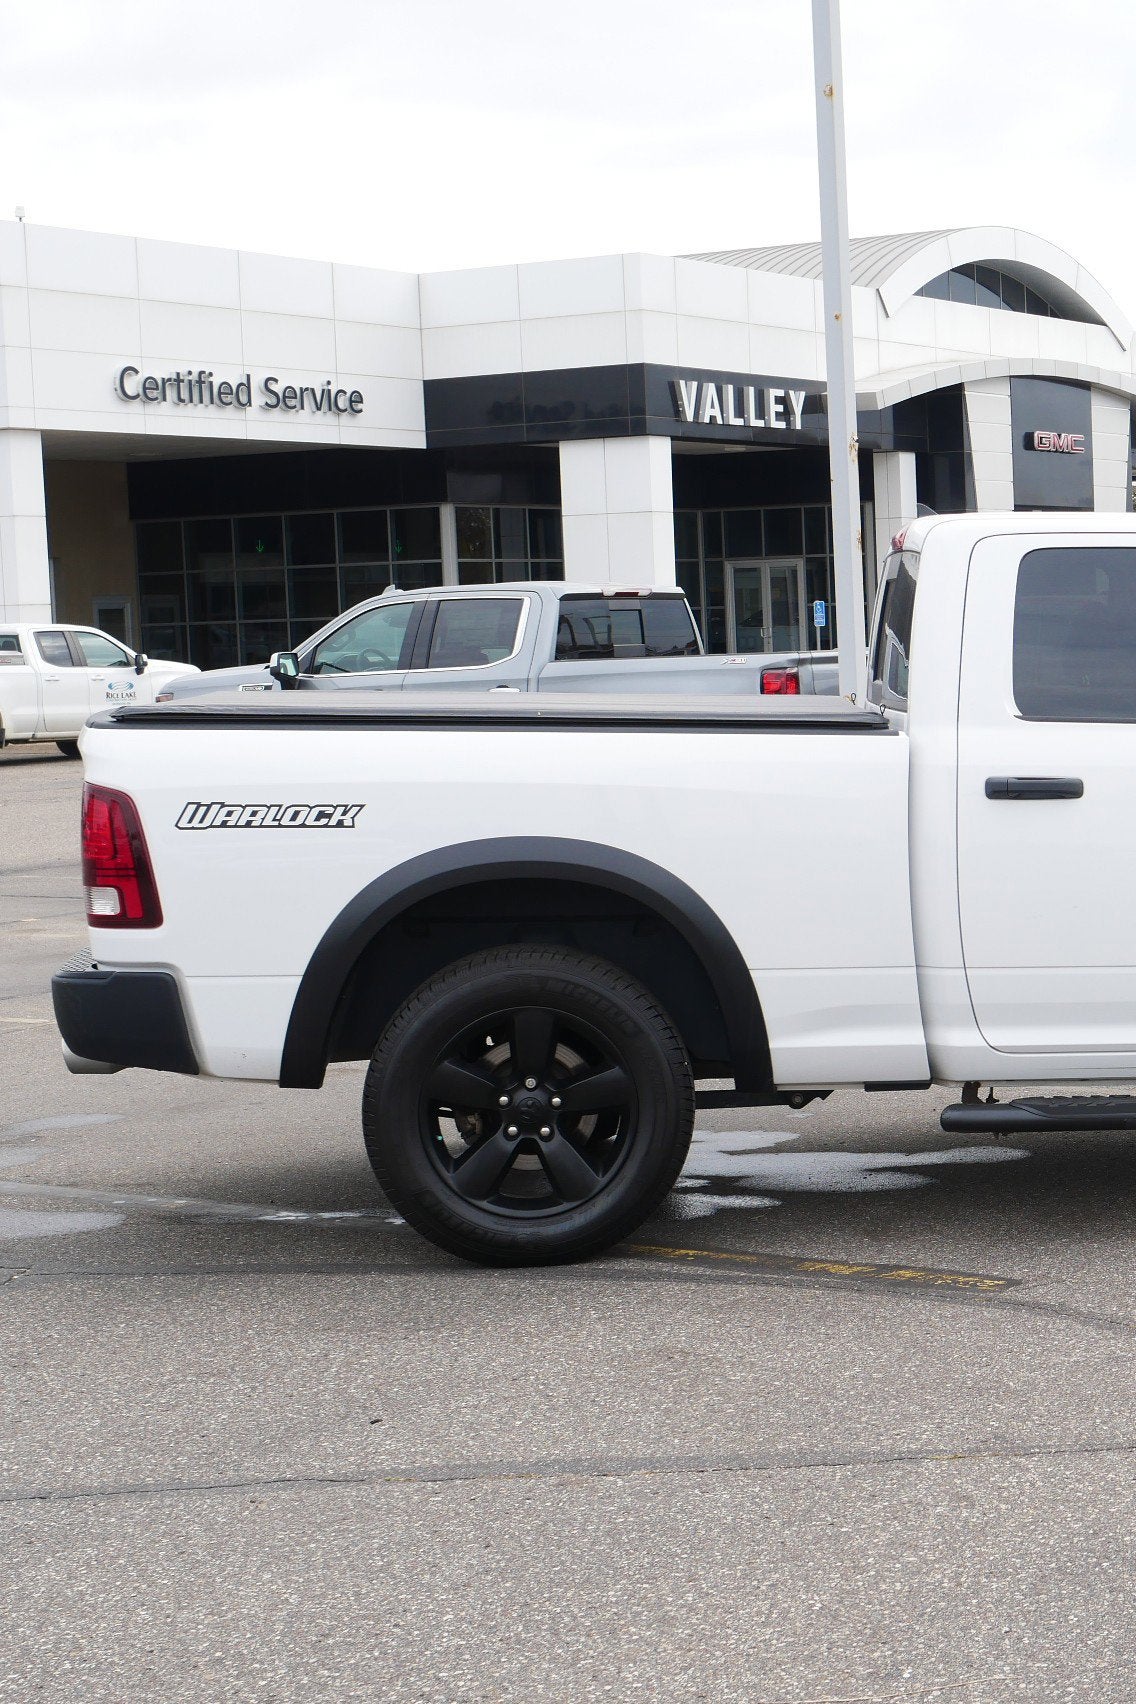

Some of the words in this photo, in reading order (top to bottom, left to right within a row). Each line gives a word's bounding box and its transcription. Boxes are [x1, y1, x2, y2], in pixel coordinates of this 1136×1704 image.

[117, 365, 253, 408] Certified
[262, 376, 364, 414] Service
[676, 379, 806, 430] VALLEY
[1033, 430, 1085, 454] GMC
[174, 801, 367, 831] WARLOCK
